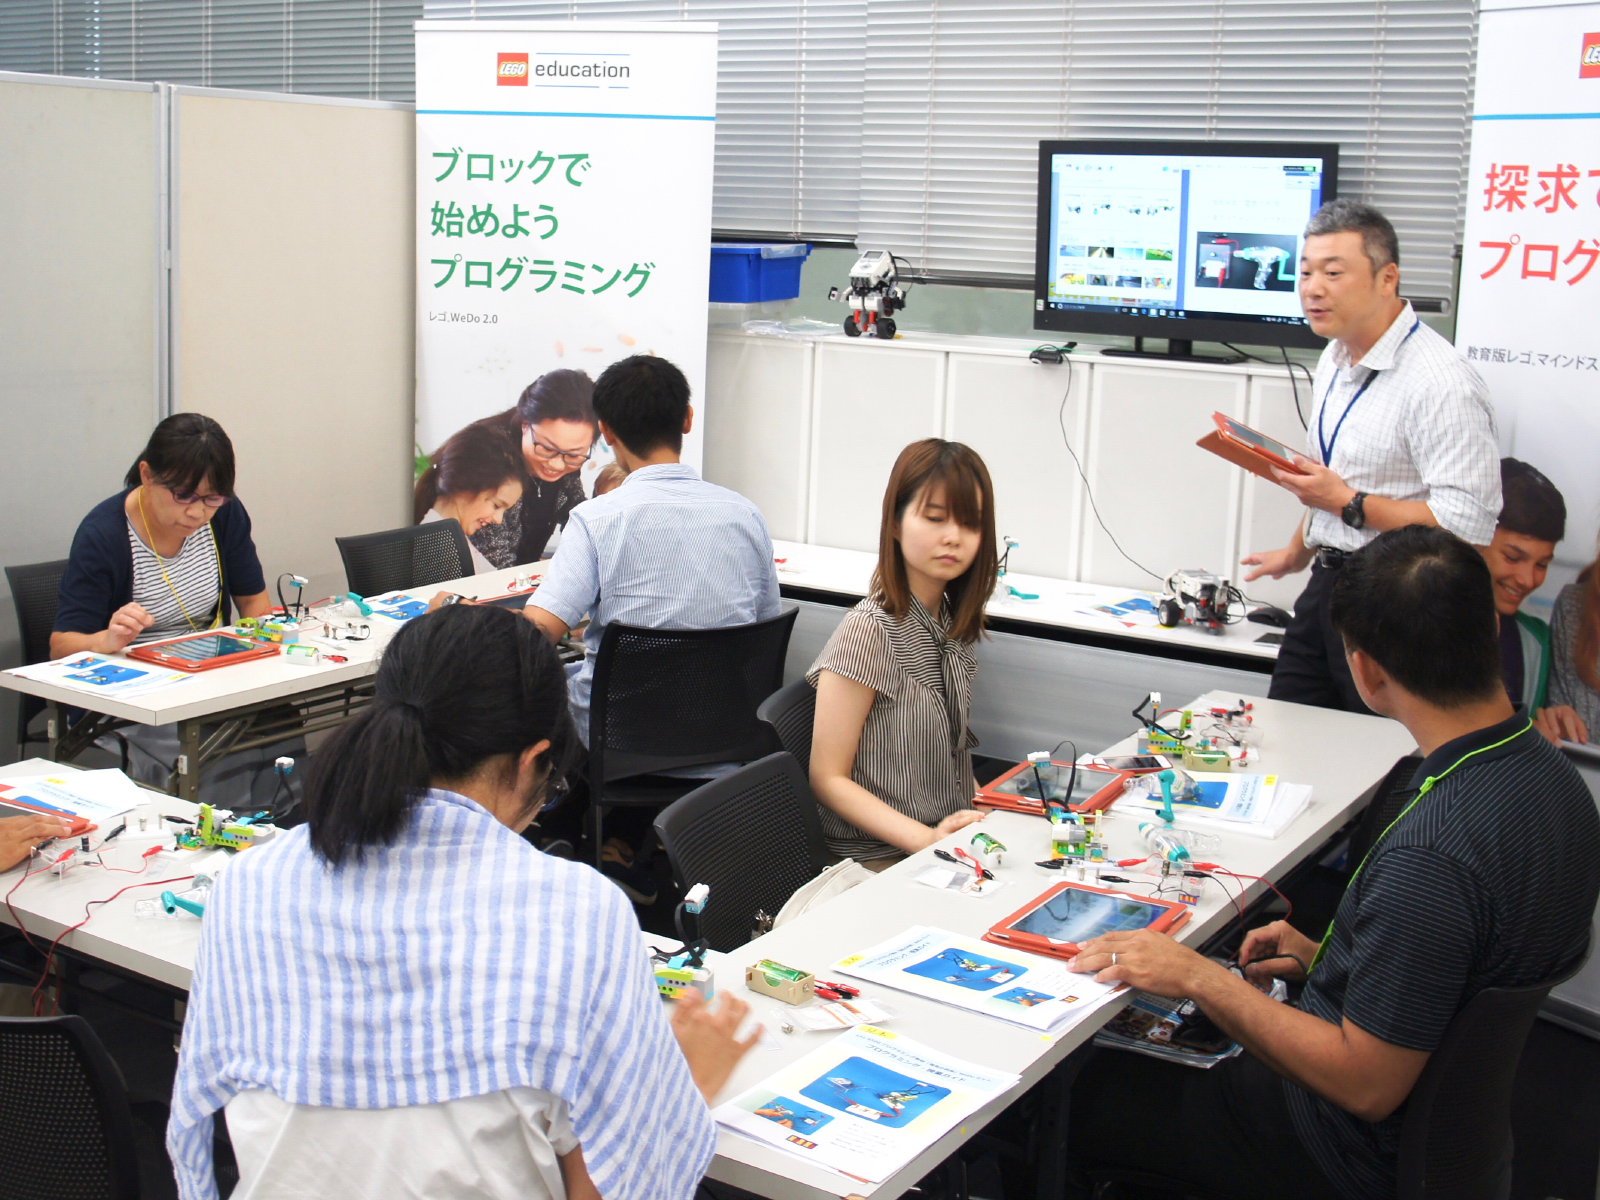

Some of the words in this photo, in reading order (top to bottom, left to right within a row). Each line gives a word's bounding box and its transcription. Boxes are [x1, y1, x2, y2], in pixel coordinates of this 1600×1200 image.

[498, 62, 528, 77] LEGO
[535, 60, 630, 78] education
[432, 147, 591, 187] ブロックで
[430, 200, 559, 240] 始めよう
[430, 253, 656, 298] プログラミング
[1479, 233, 1600, 286] プログ
[483, 314, 498, 324] 2.0
